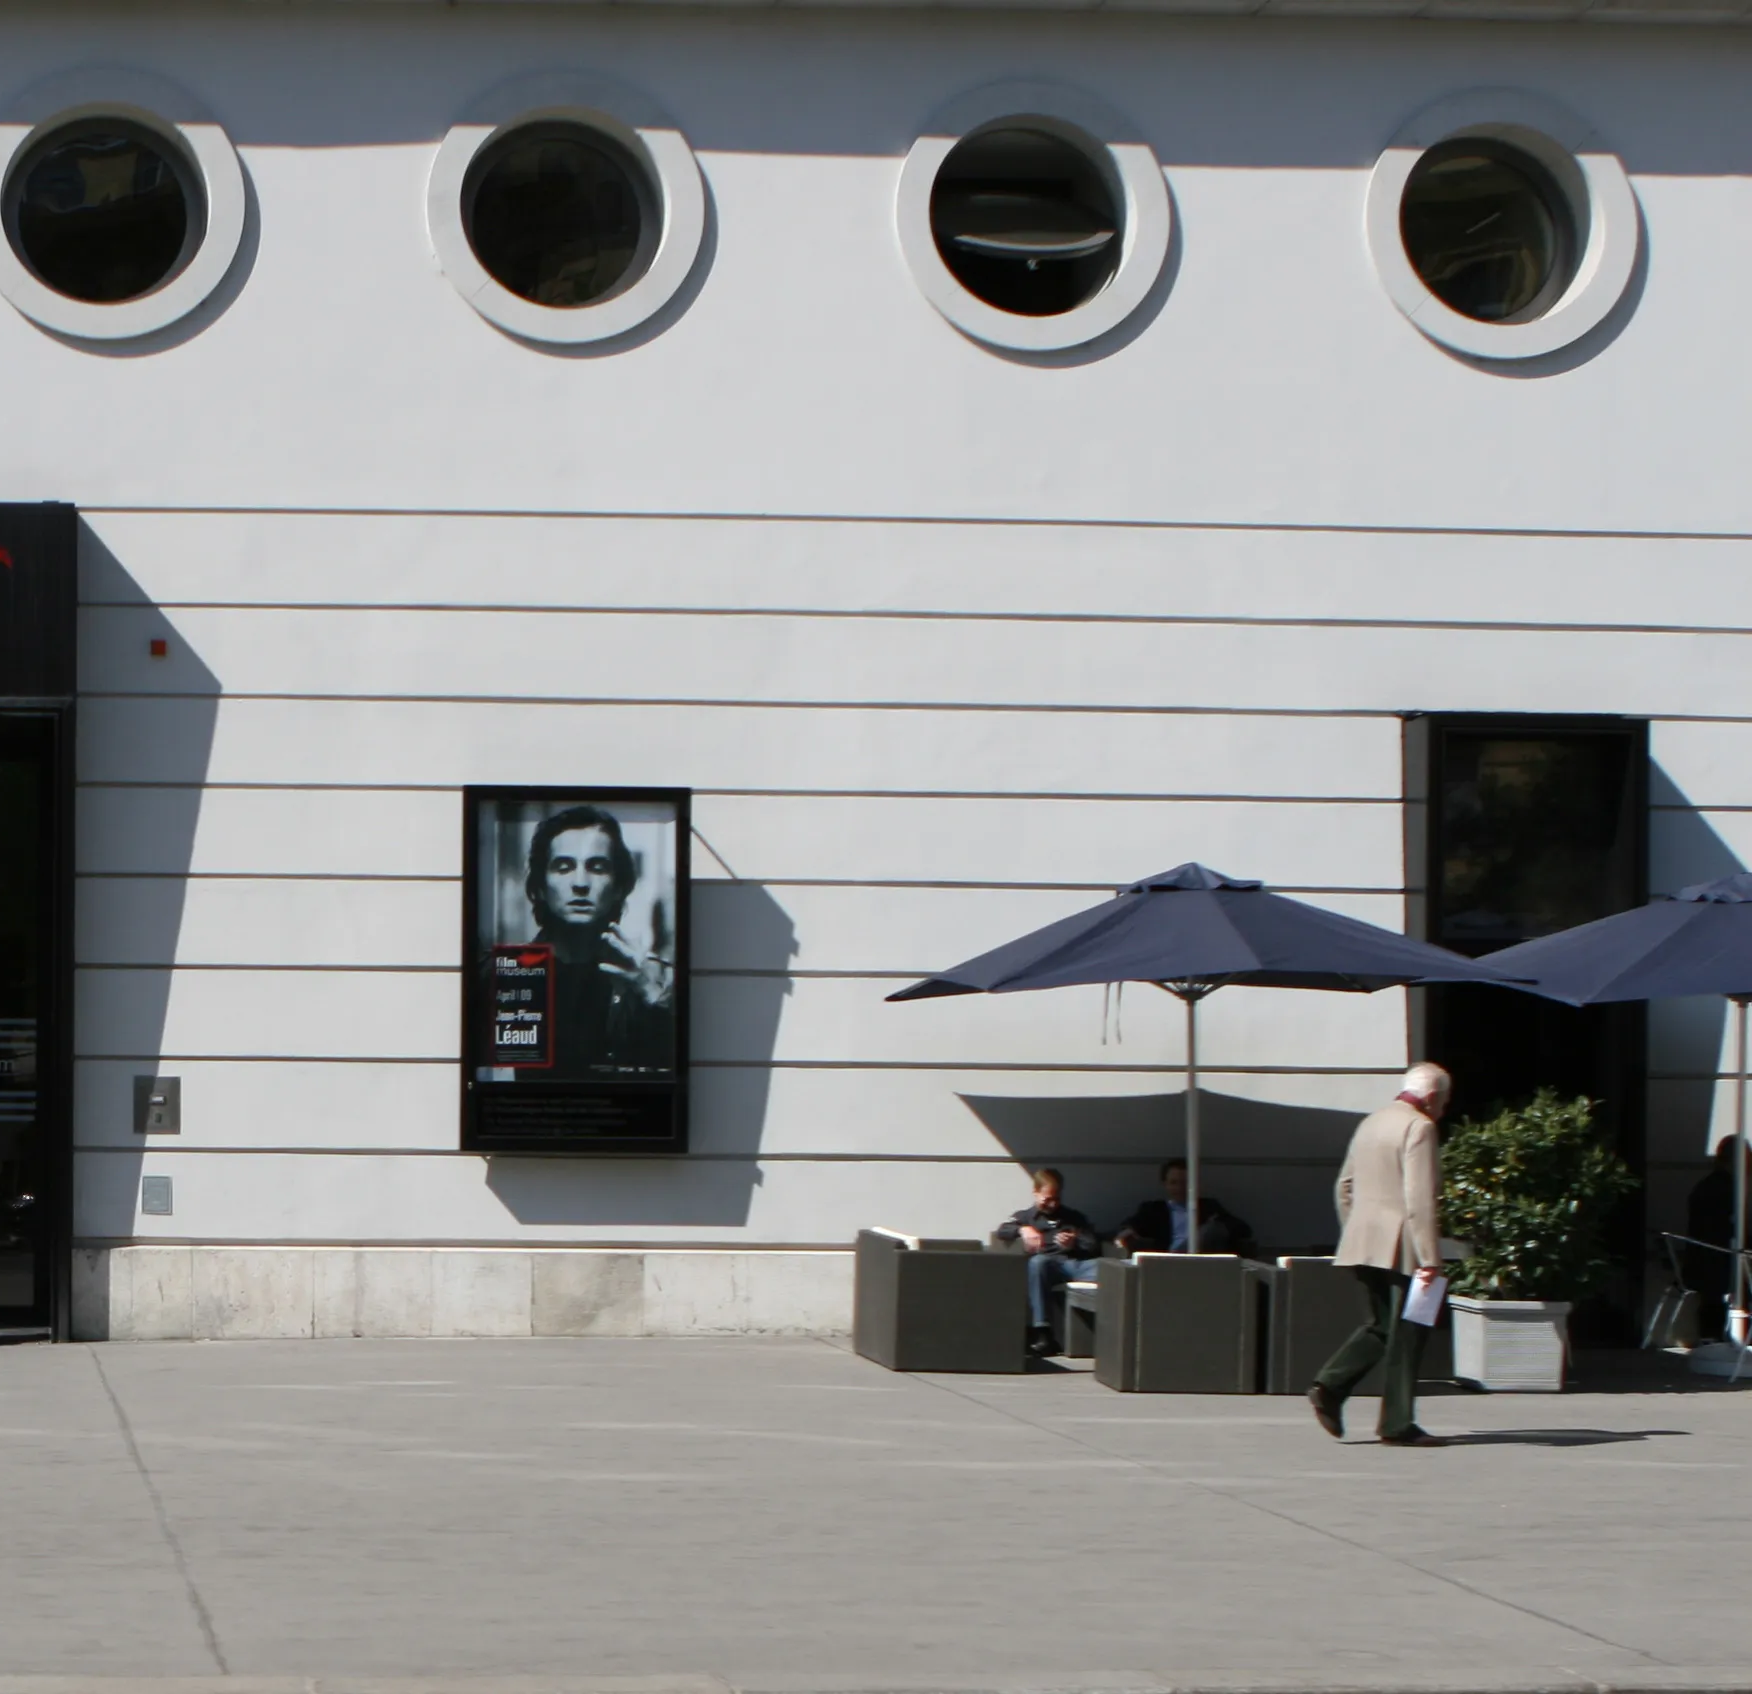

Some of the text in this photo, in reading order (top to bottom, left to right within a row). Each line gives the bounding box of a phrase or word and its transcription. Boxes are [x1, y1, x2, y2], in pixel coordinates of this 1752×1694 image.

[496, 956, 517, 968] film
[496, 967, 546, 976] museum
[495, 1024, 538, 1045] Léaud
